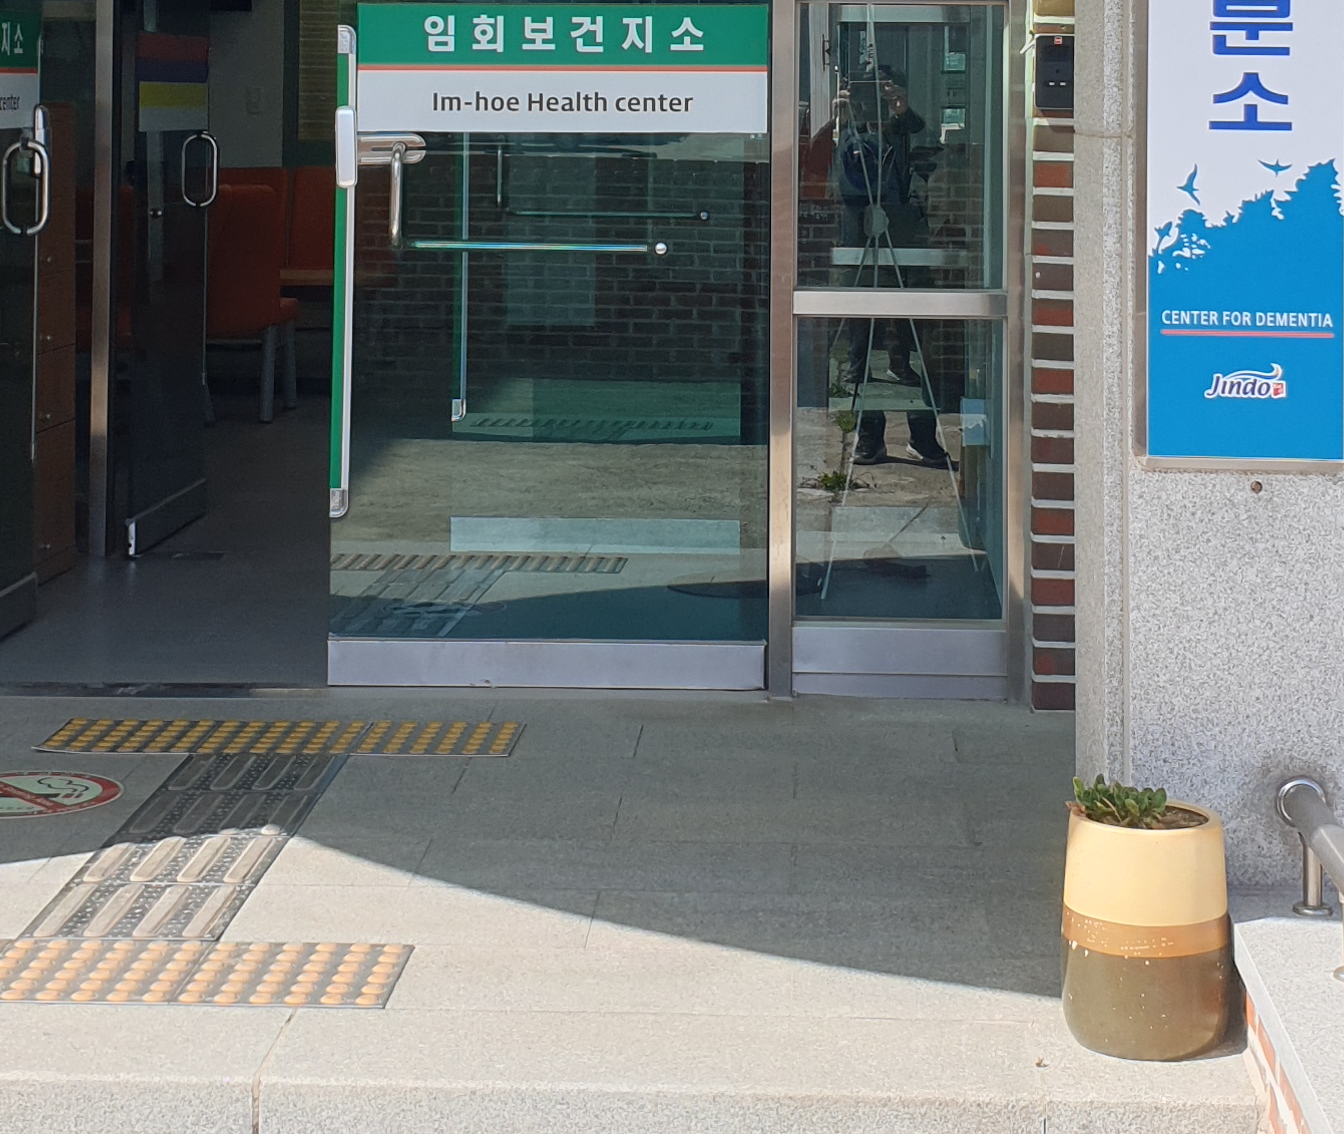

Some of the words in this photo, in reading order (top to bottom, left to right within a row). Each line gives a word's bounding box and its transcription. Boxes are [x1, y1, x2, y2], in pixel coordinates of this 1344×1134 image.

[422, 14, 706, 54] 임회보건지소
[432, 91, 521, 114] Im-hoe
[526, 90, 609, 114] Health
[614, 92, 694, 114] center
[1162, 310, 1219, 326] CENTER
[1222, 310, 1252, 327] FOR
[1255, 312, 1333, 328] DEMENTIA
